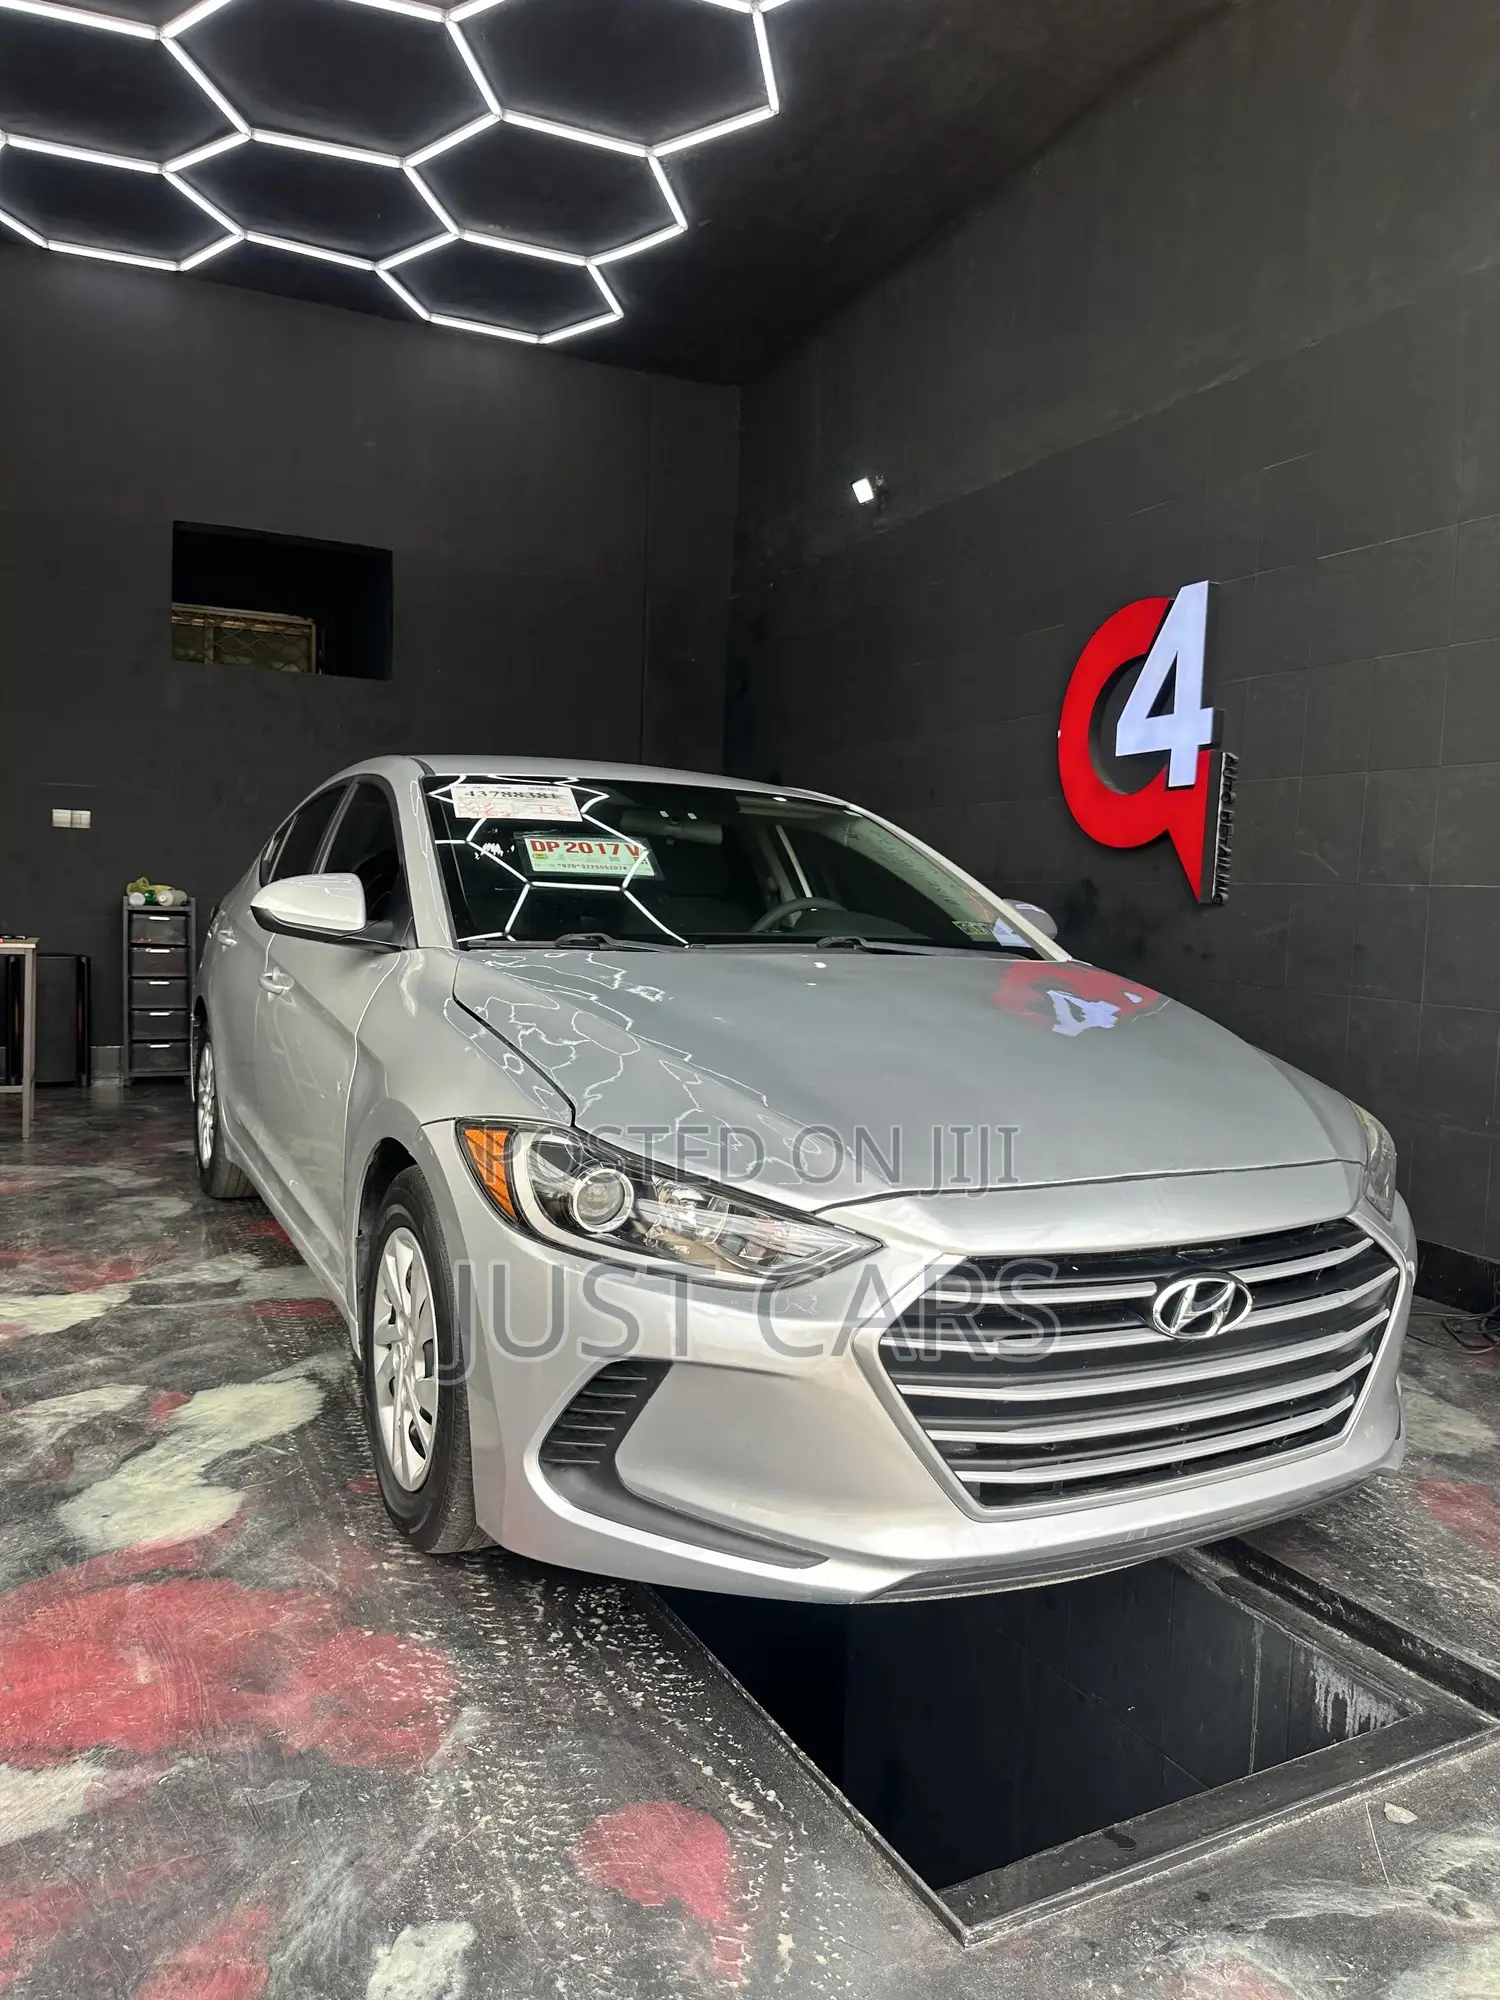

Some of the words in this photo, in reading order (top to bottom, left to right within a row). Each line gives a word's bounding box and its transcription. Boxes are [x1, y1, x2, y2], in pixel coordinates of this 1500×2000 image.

[1219, 752, 1239, 803] AUTO
[530, 840, 560, 853] DP
[564, 841, 620, 855] 2017
